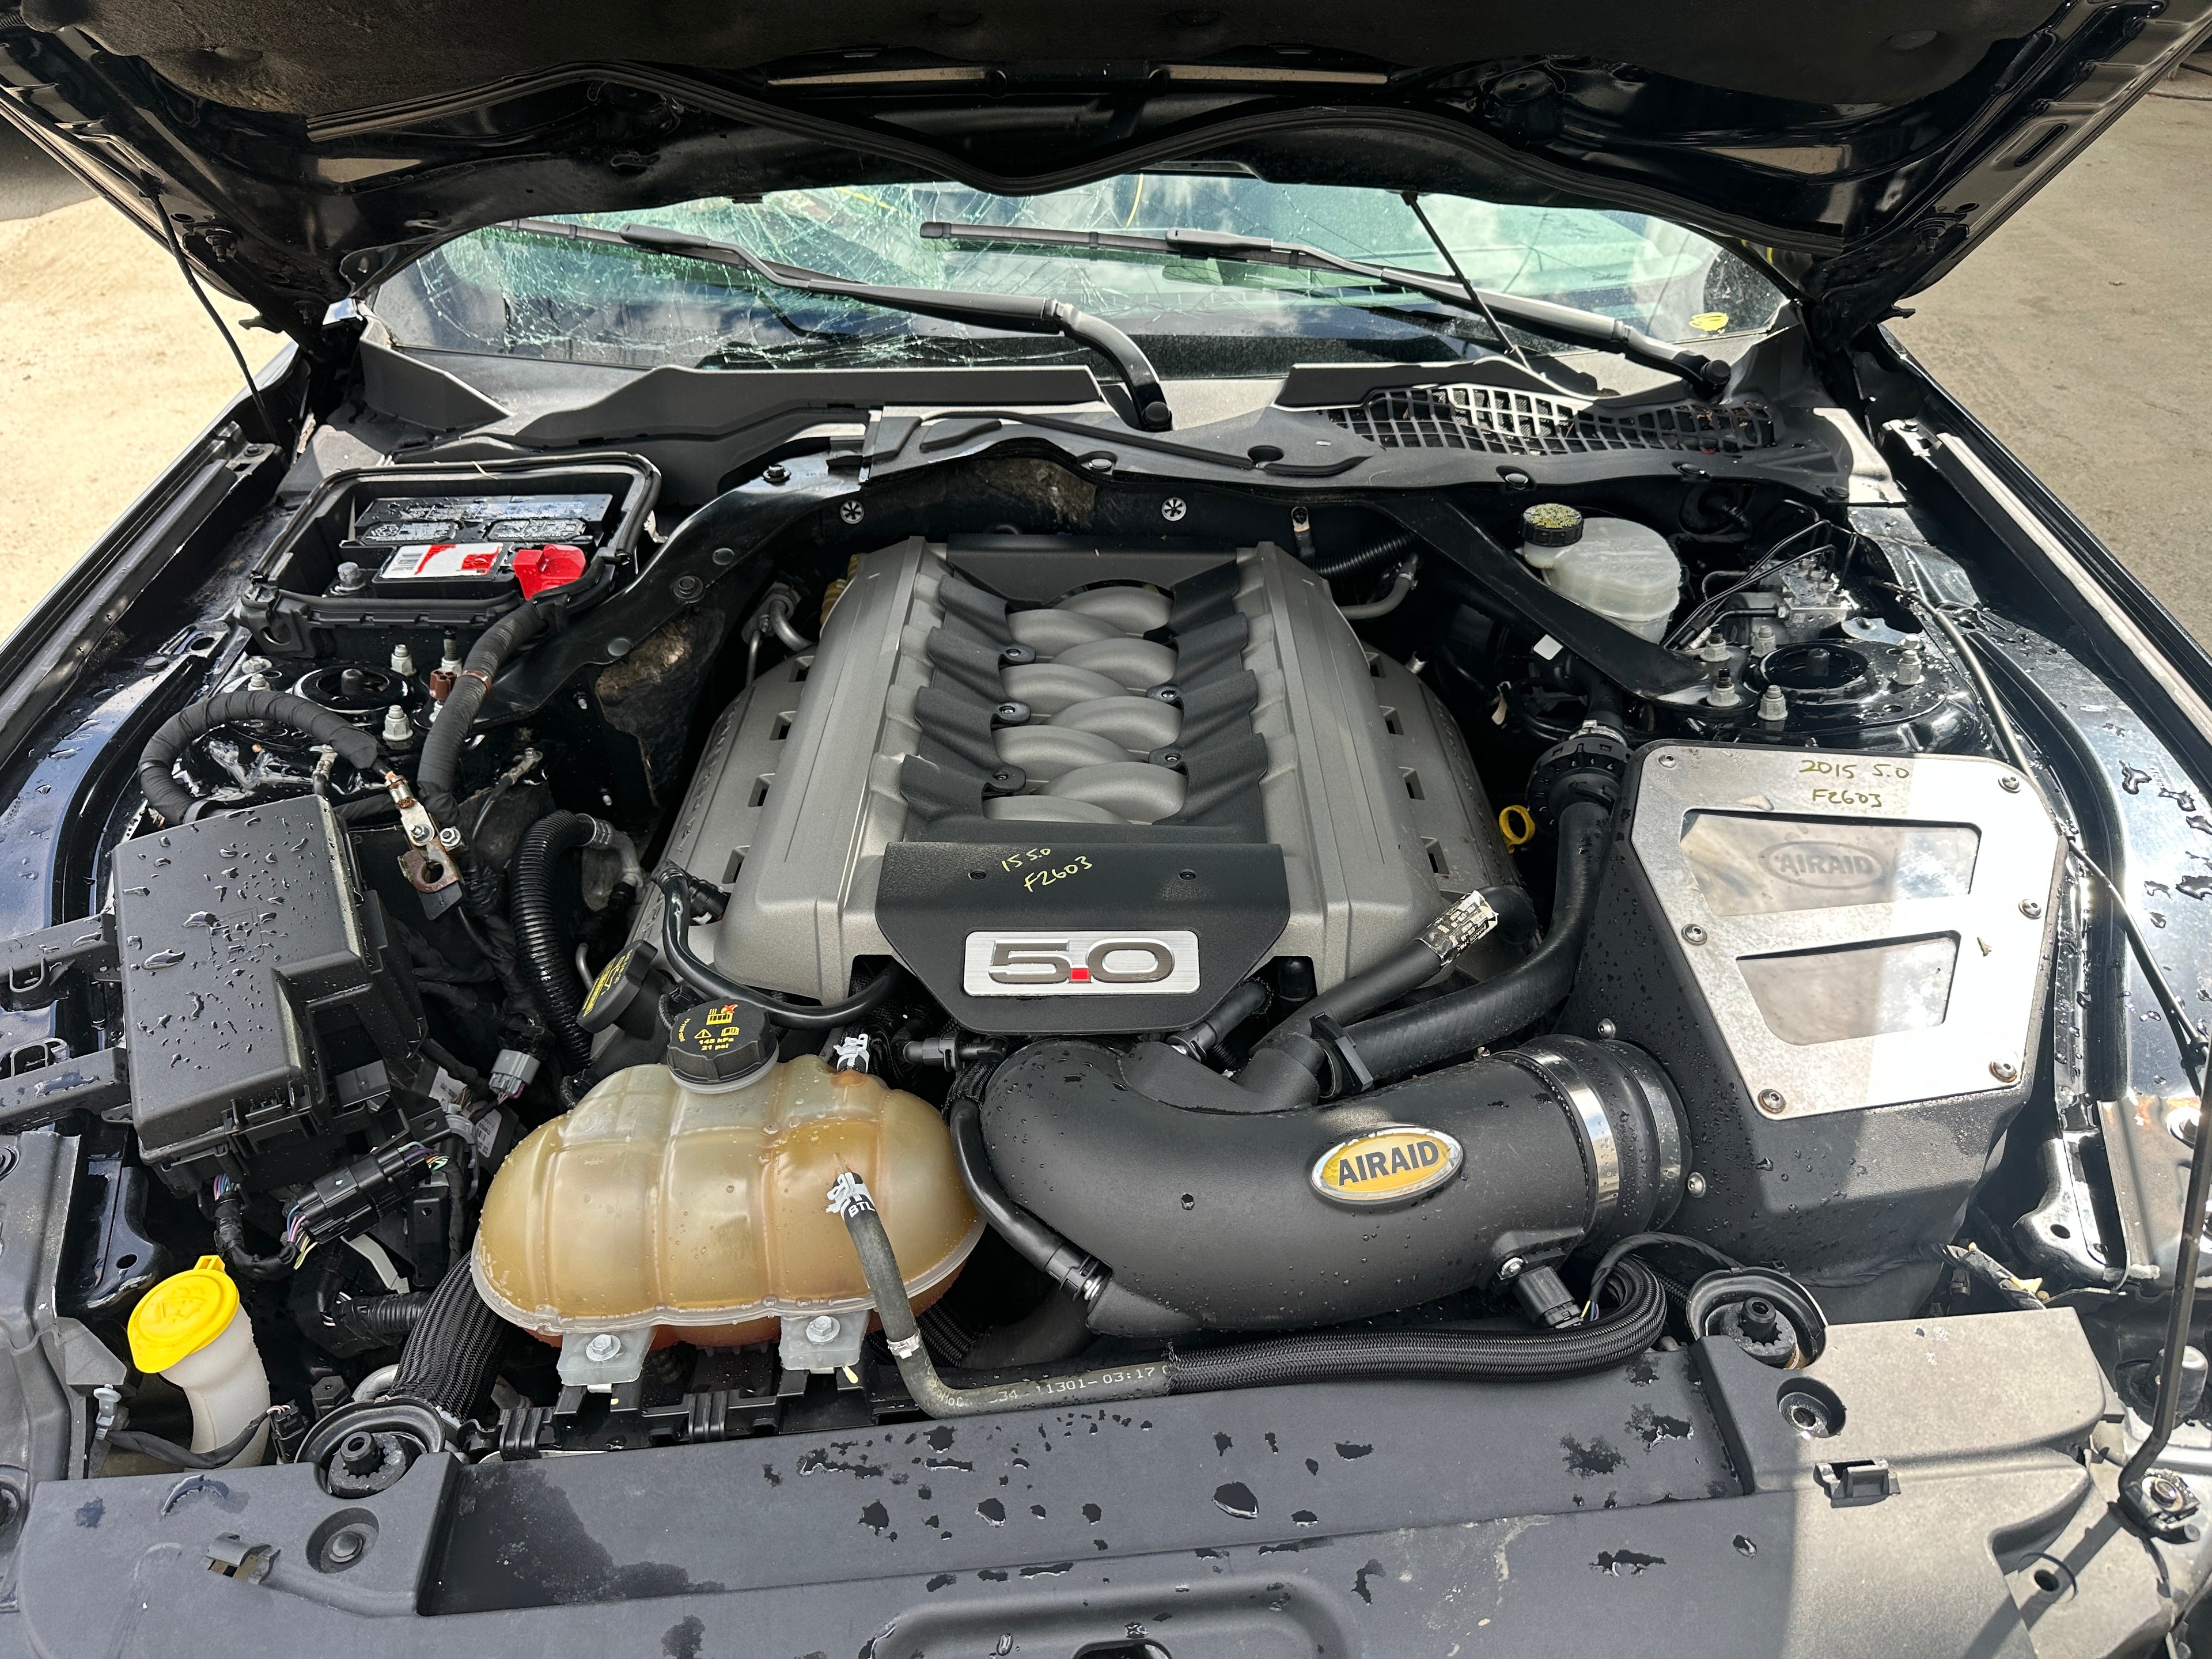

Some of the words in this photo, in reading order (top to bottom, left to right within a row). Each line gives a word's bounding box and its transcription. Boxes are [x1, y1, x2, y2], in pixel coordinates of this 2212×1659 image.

[1799, 759, 1858, 779] 2015
[1872, 763, 1910, 779] 5.0
[1812, 789, 1883, 808] F2603
[1001, 853, 1024, 872] 15
[1779, 853, 1874, 875] AIRAID
[1024, 855, 1093, 893] F2603
[987, 938, 1175, 985] 5.0
[1338, 1140, 1440, 1187] AIRAID
